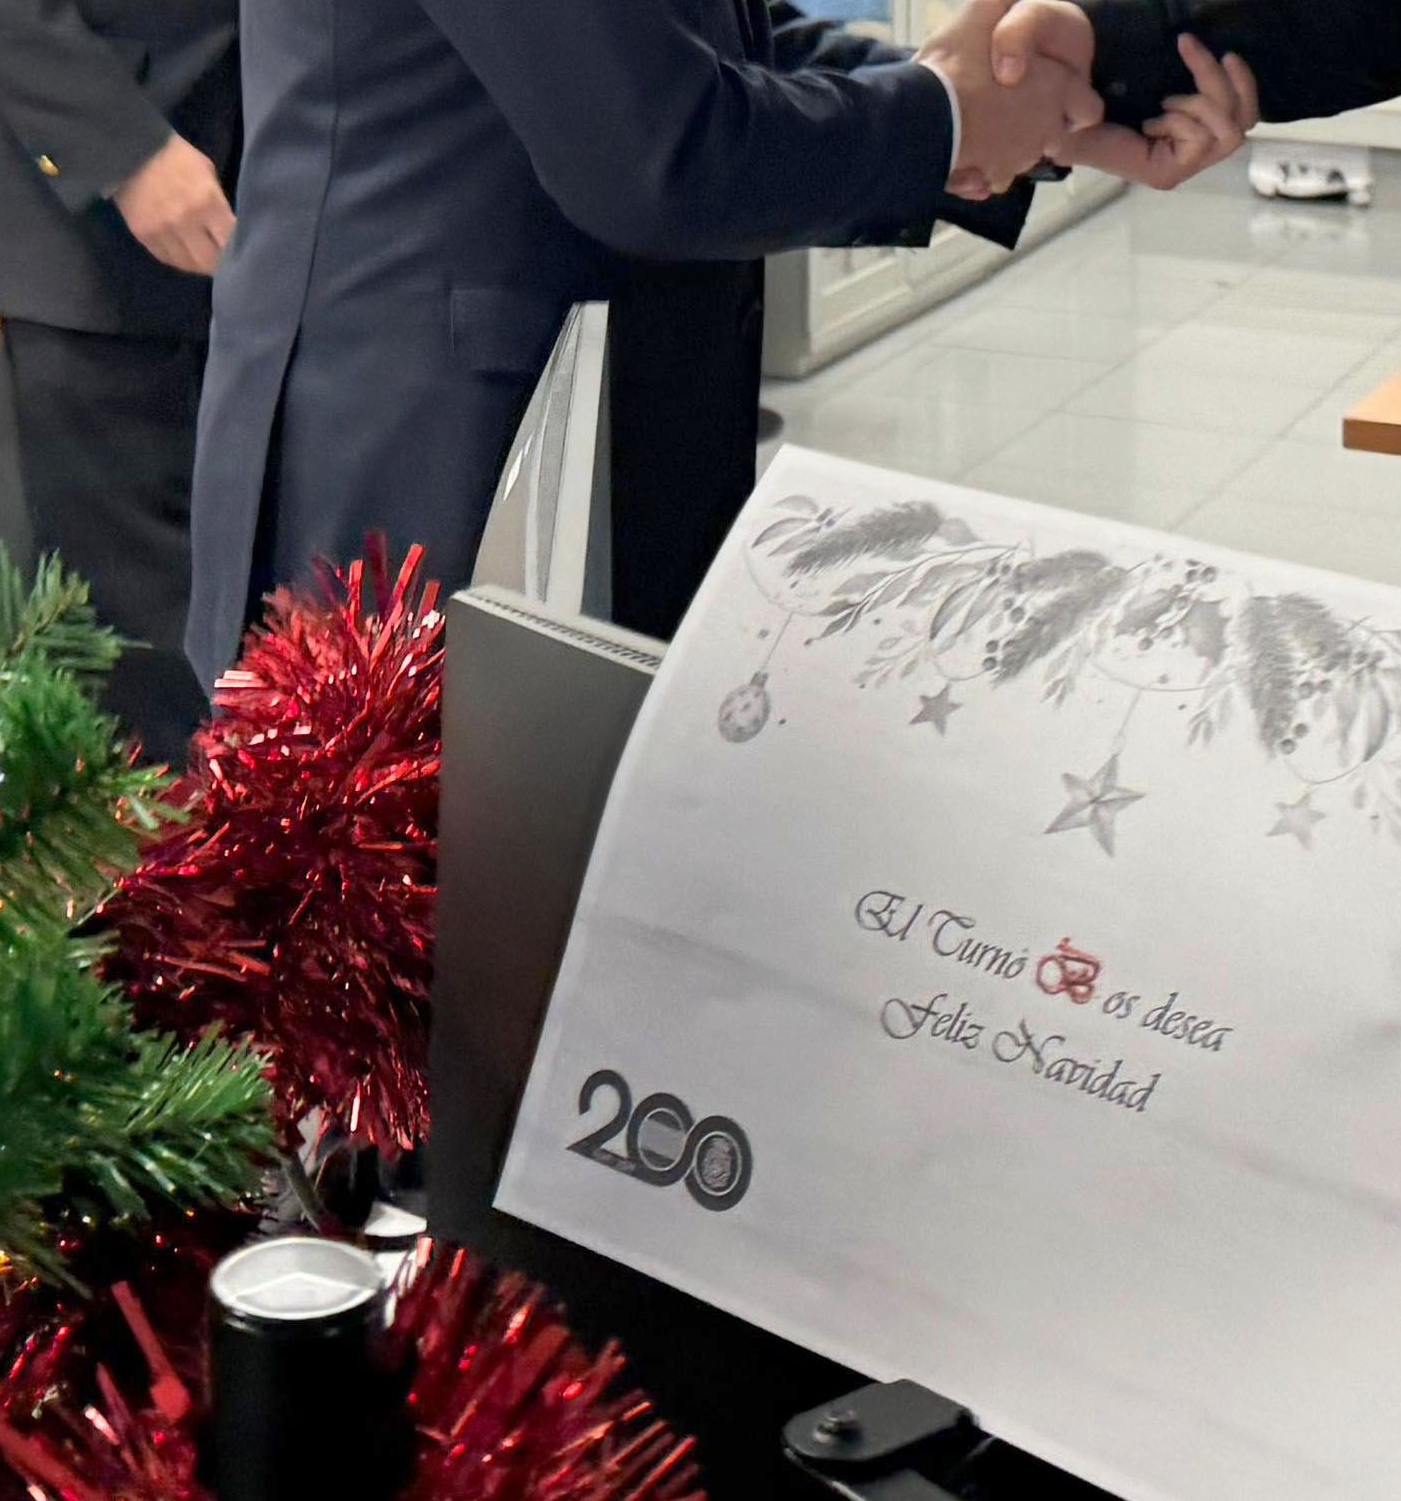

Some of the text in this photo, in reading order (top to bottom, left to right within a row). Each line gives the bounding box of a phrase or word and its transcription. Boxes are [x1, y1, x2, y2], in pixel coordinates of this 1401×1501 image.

[854, 890, 924, 941] El
[1103, 990, 1141, 1020] os
[1141, 992, 1234, 1052] desea
[881, 993, 1161, 1112] Feliz Navidad
[566, 1068, 753, 1212] 200
